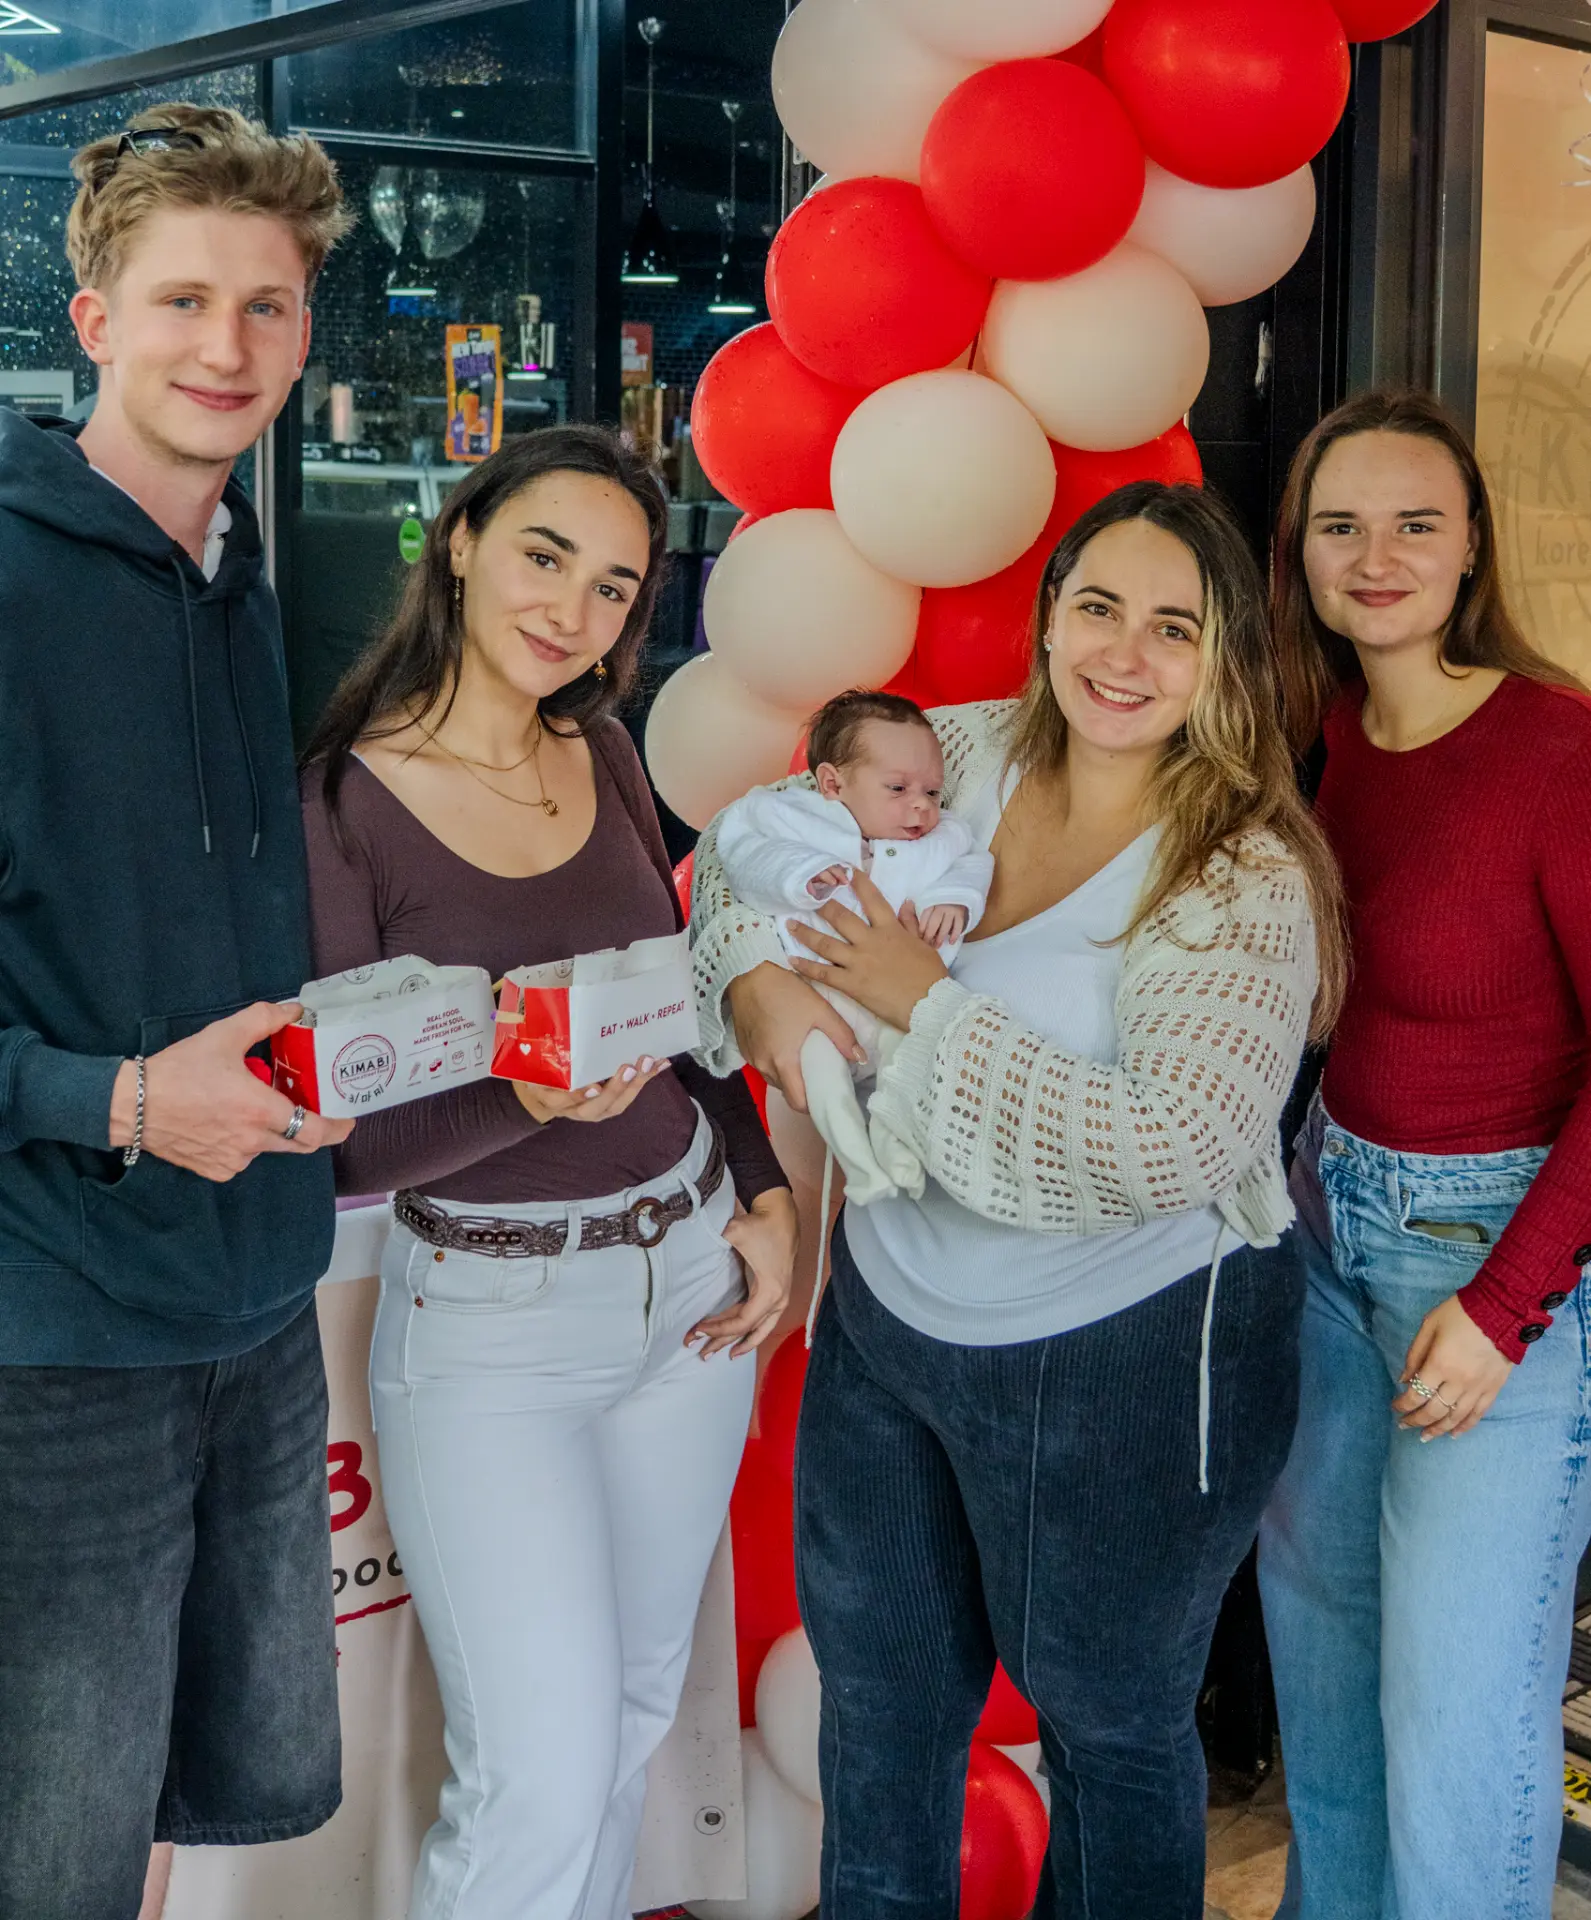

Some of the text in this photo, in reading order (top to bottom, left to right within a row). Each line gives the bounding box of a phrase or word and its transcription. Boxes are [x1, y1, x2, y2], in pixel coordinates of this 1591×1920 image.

[422, 1020, 448, 1033] KOREAN
[427, 1014, 442, 1023] REAL
[600, 1000, 685, 1038] EAT WALK REPEAT
[414, 1035, 431, 1045] MADE
[431, 1030, 449, 1040] FRESH
[450, 1025, 462, 1034] FOR
[340, 1055, 390, 1078] KIMABI
